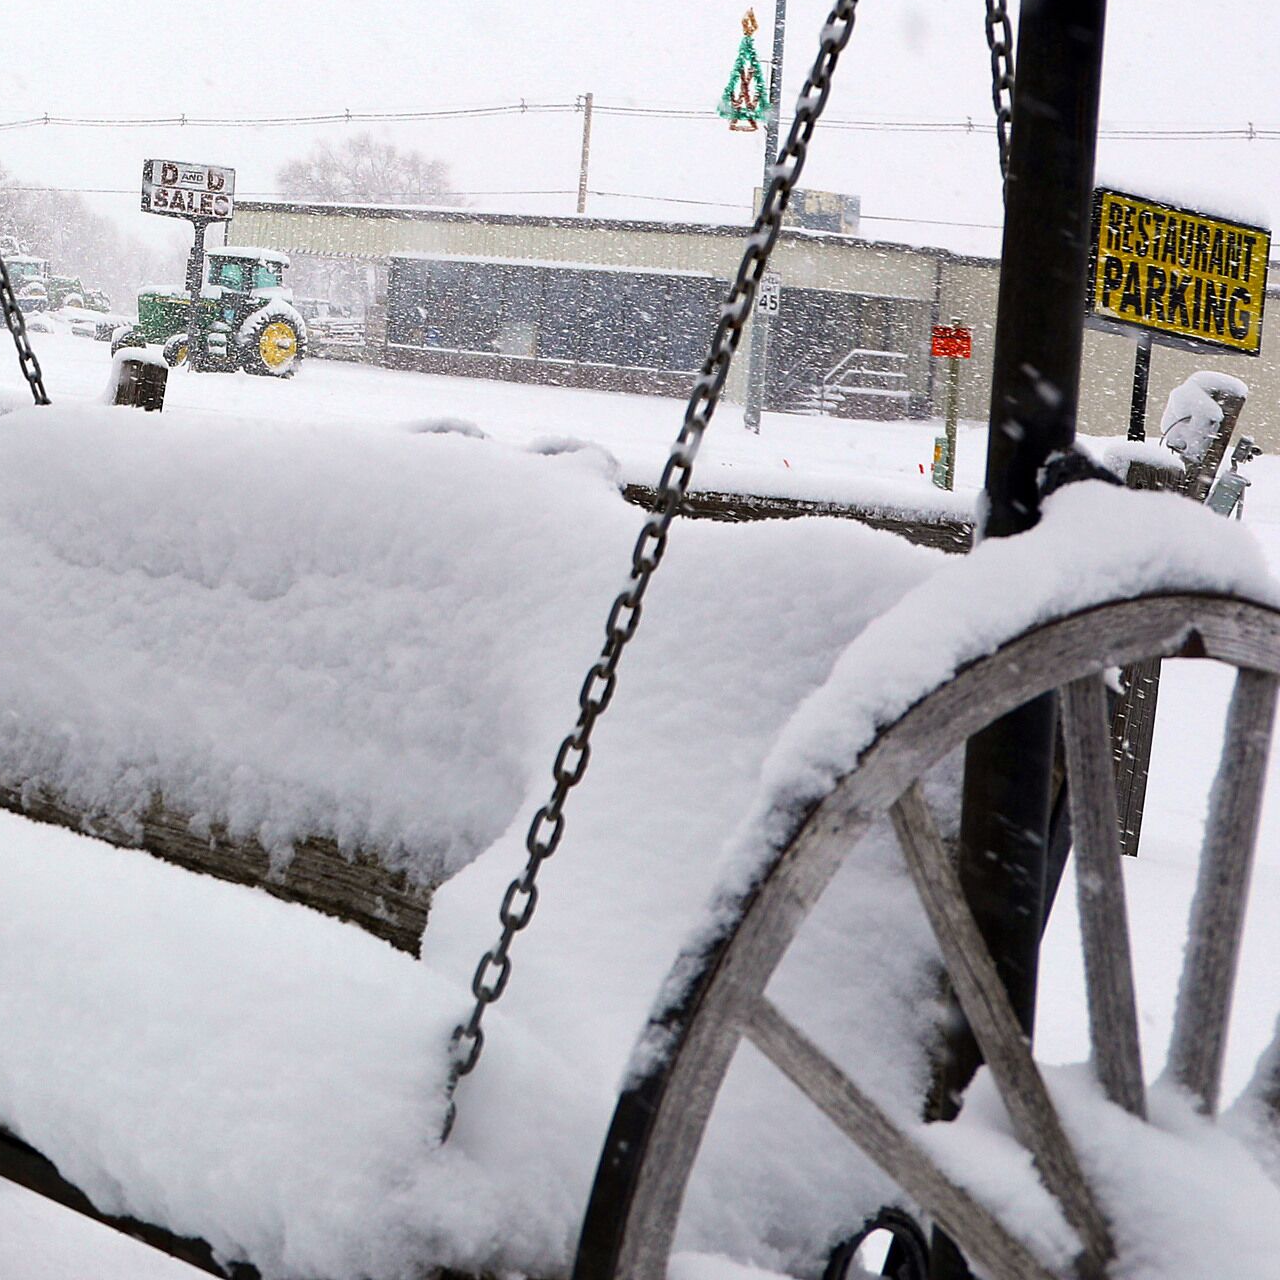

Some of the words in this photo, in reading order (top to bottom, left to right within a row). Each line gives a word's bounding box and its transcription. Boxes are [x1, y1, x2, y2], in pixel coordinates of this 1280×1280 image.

[161, 163, 178, 186] D
[182, 173, 203, 182] AND
[1106, 201, 1257, 283] RESTAURANT
[759, 295, 778, 310] 45
[1101, 255, 1252, 340] PARKING
